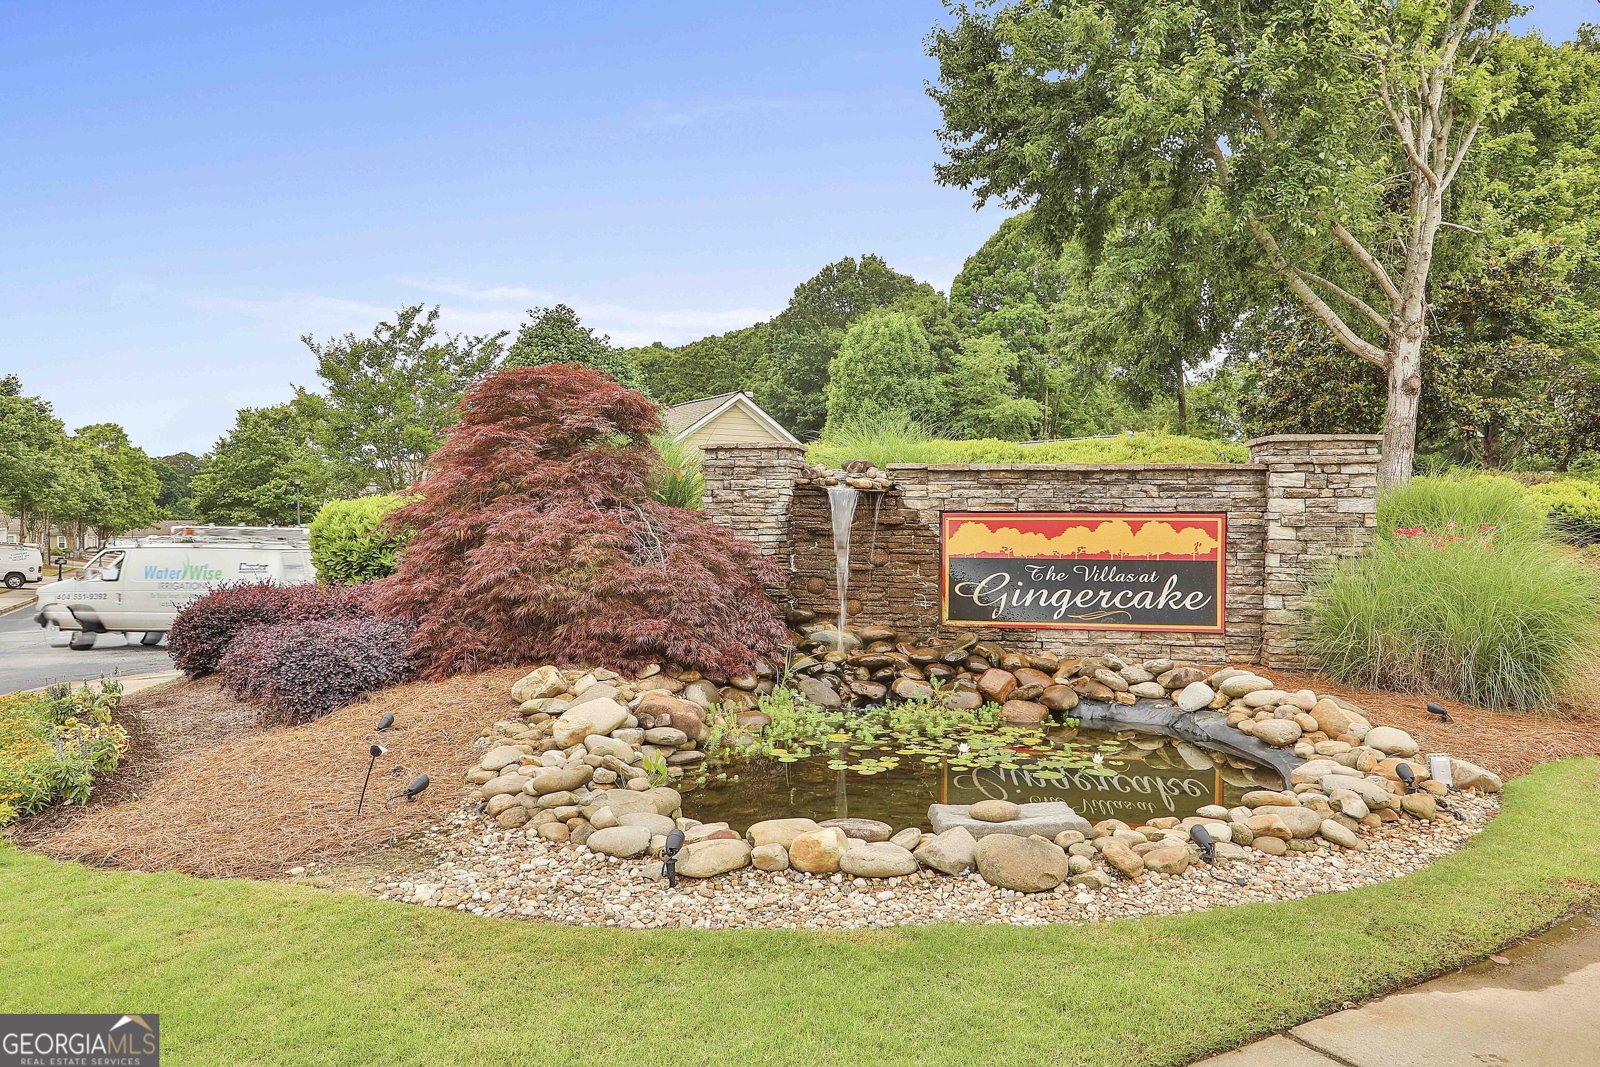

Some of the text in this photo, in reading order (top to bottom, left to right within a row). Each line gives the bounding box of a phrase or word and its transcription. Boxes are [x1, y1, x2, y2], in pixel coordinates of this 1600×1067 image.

[144, 565, 182, 580] Water
[190, 563, 222, 580] Wise
[1024, 564, 1160, 583] The Villas at
[954, 573, 1213, 620] Gingercake
